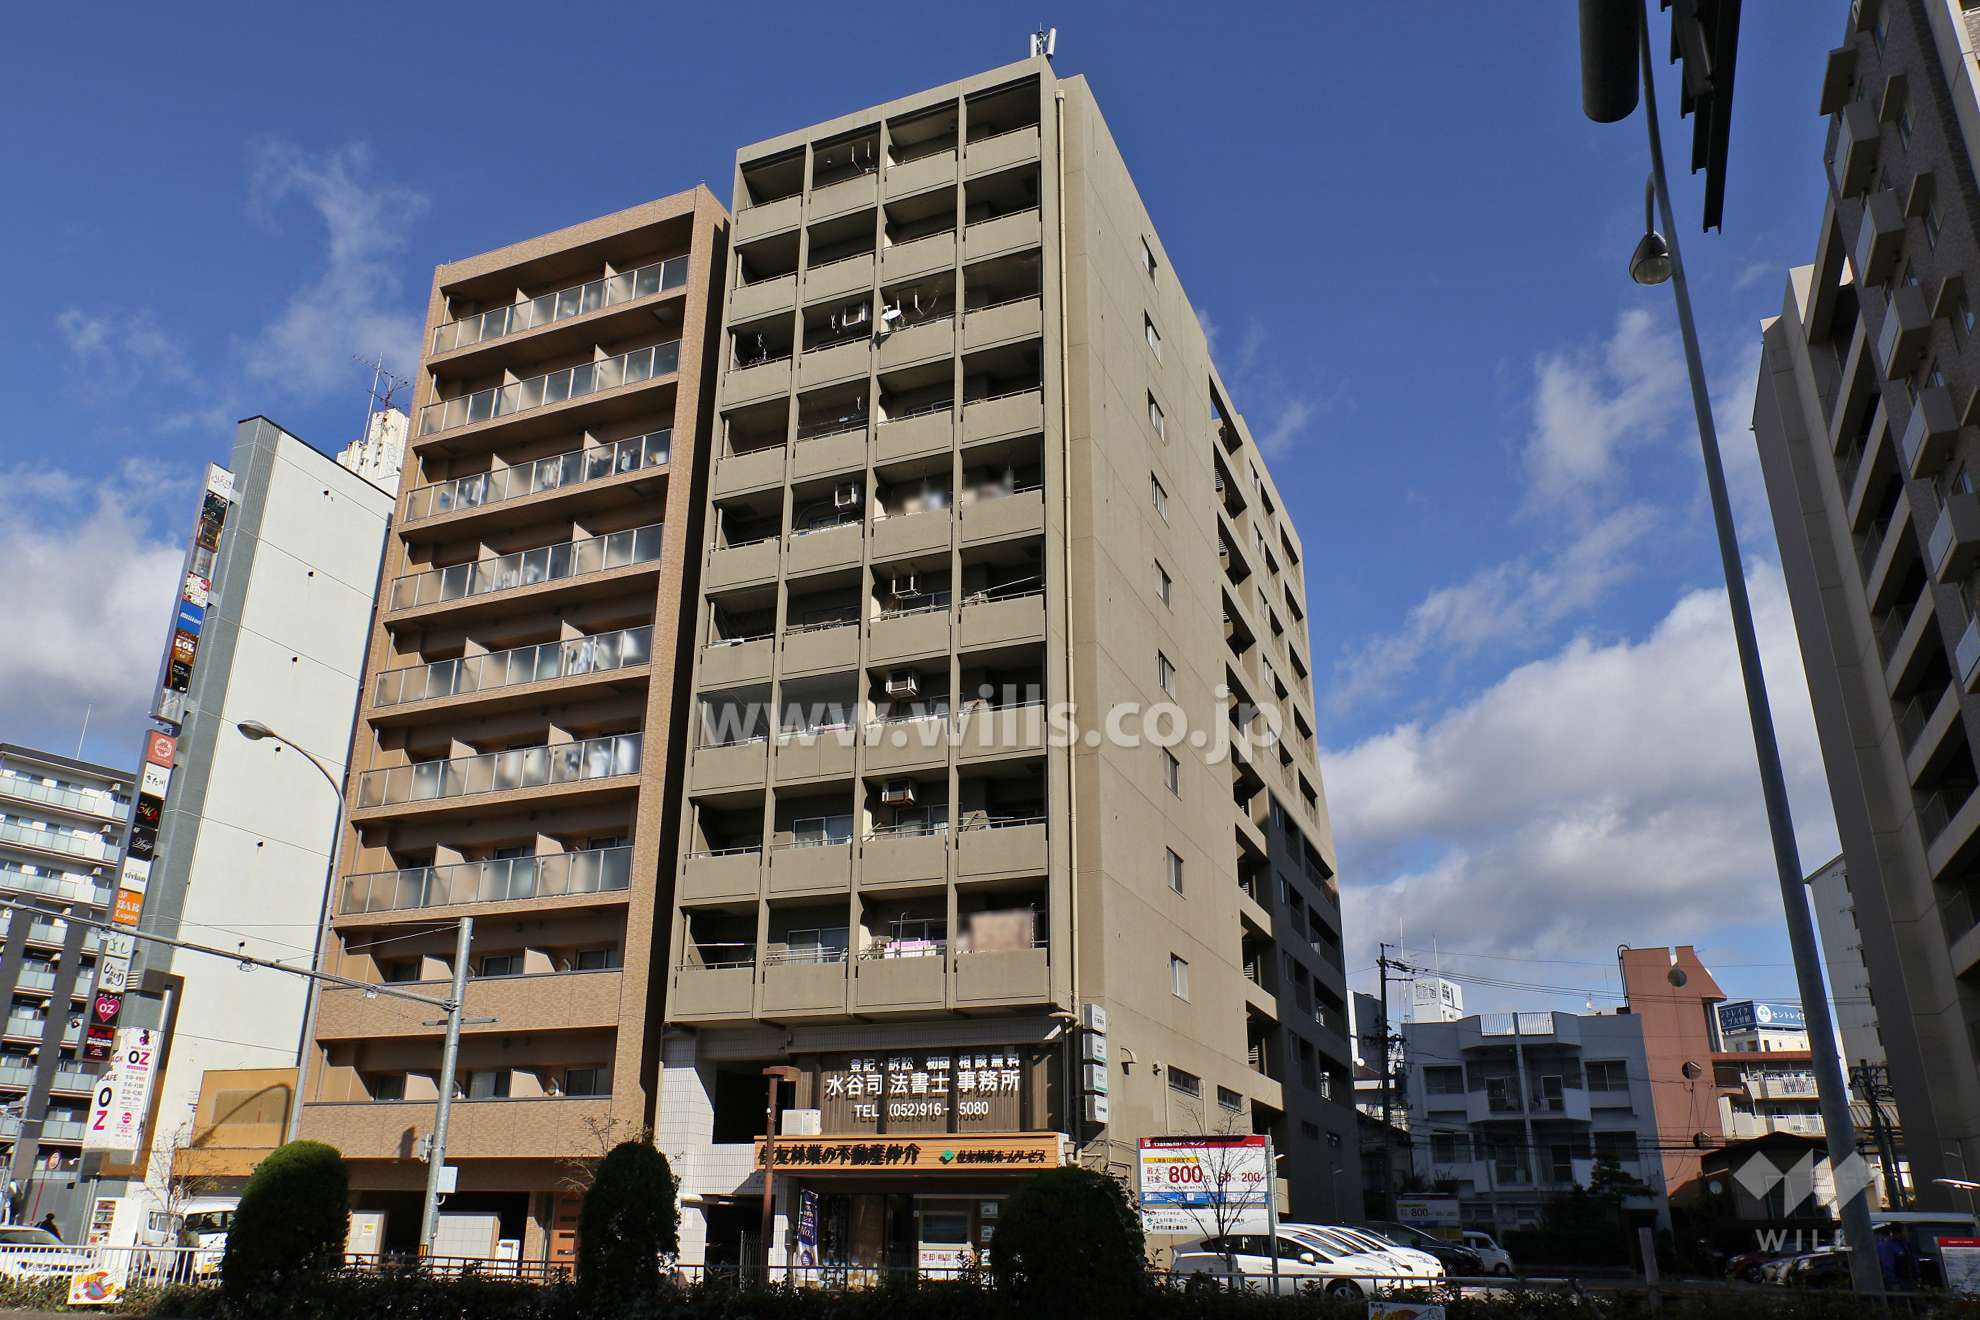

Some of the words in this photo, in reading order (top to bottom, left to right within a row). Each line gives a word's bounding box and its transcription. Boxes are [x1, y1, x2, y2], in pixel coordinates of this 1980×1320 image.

[99, 1003, 115, 1014] OZ
[128, 1050, 151, 1065] OZ
[854, 1104, 880, 1118] TEL
